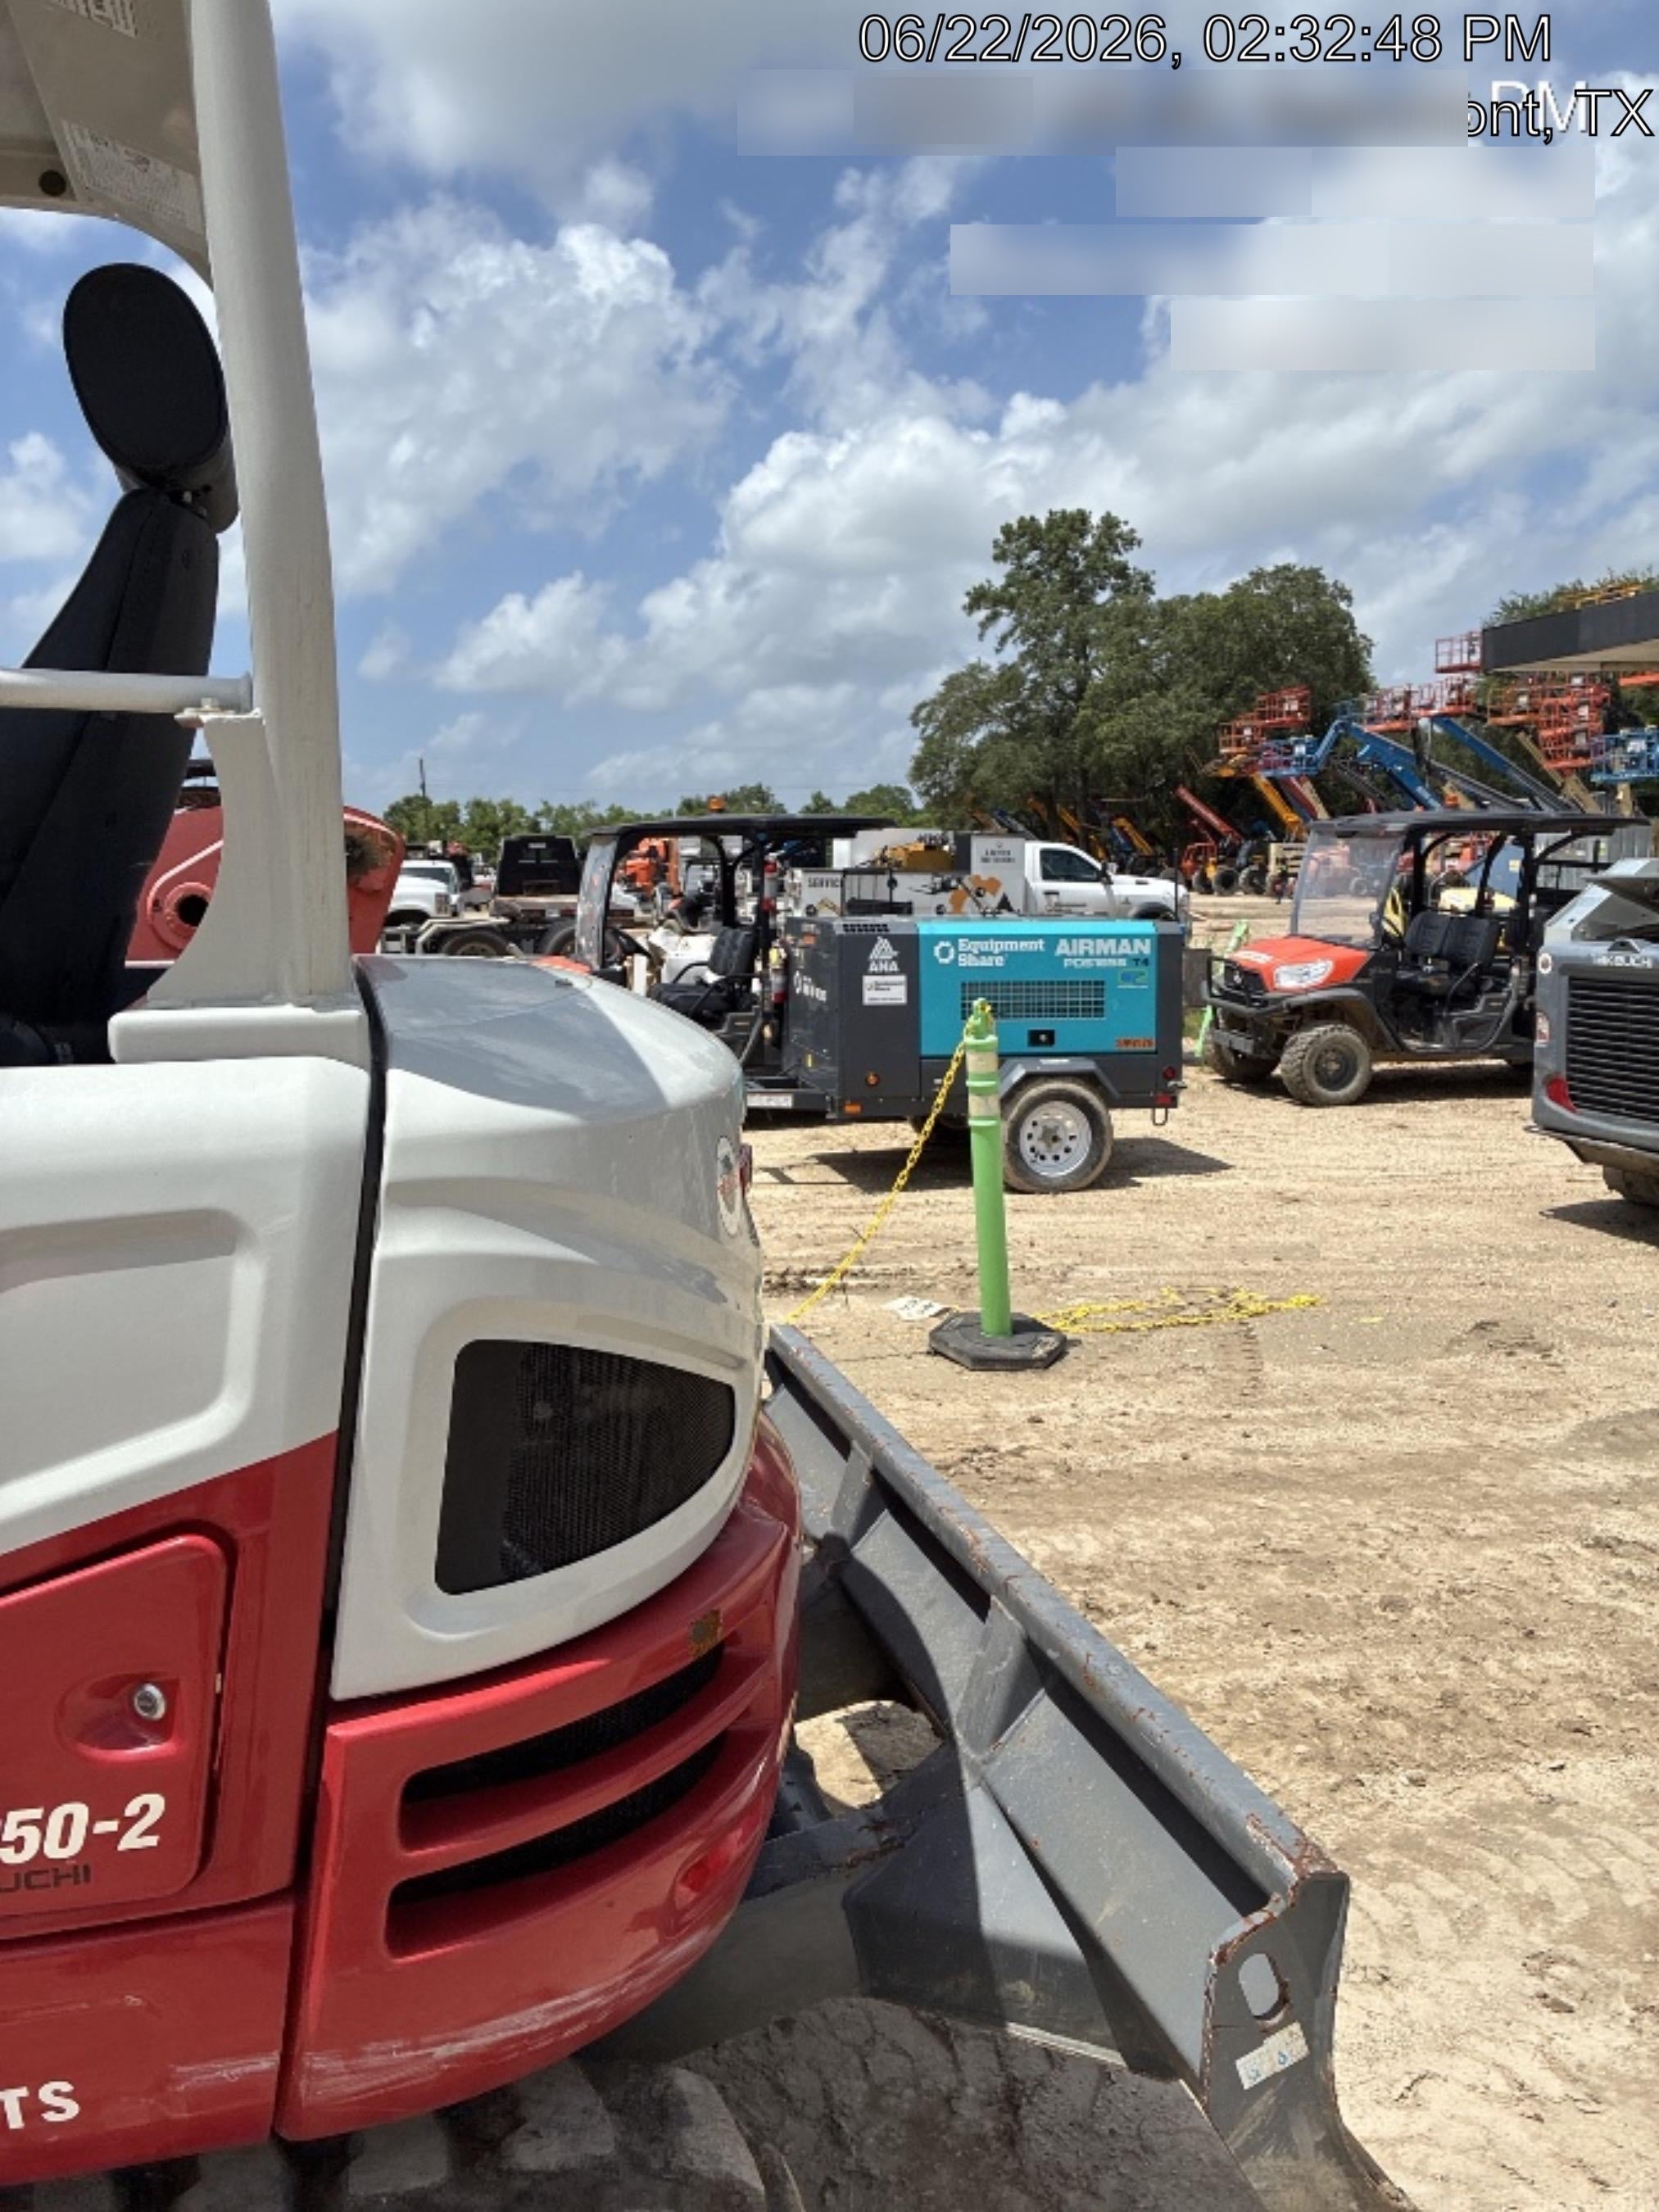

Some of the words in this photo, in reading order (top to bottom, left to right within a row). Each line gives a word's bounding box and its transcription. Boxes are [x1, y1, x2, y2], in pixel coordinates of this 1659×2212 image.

[958, 938, 1045, 954] Equipment
[1055, 938, 1151, 957] AIRMAN
[958, 954, 1005, 967] Share
[0, 1793, 166, 1865] 50-2
